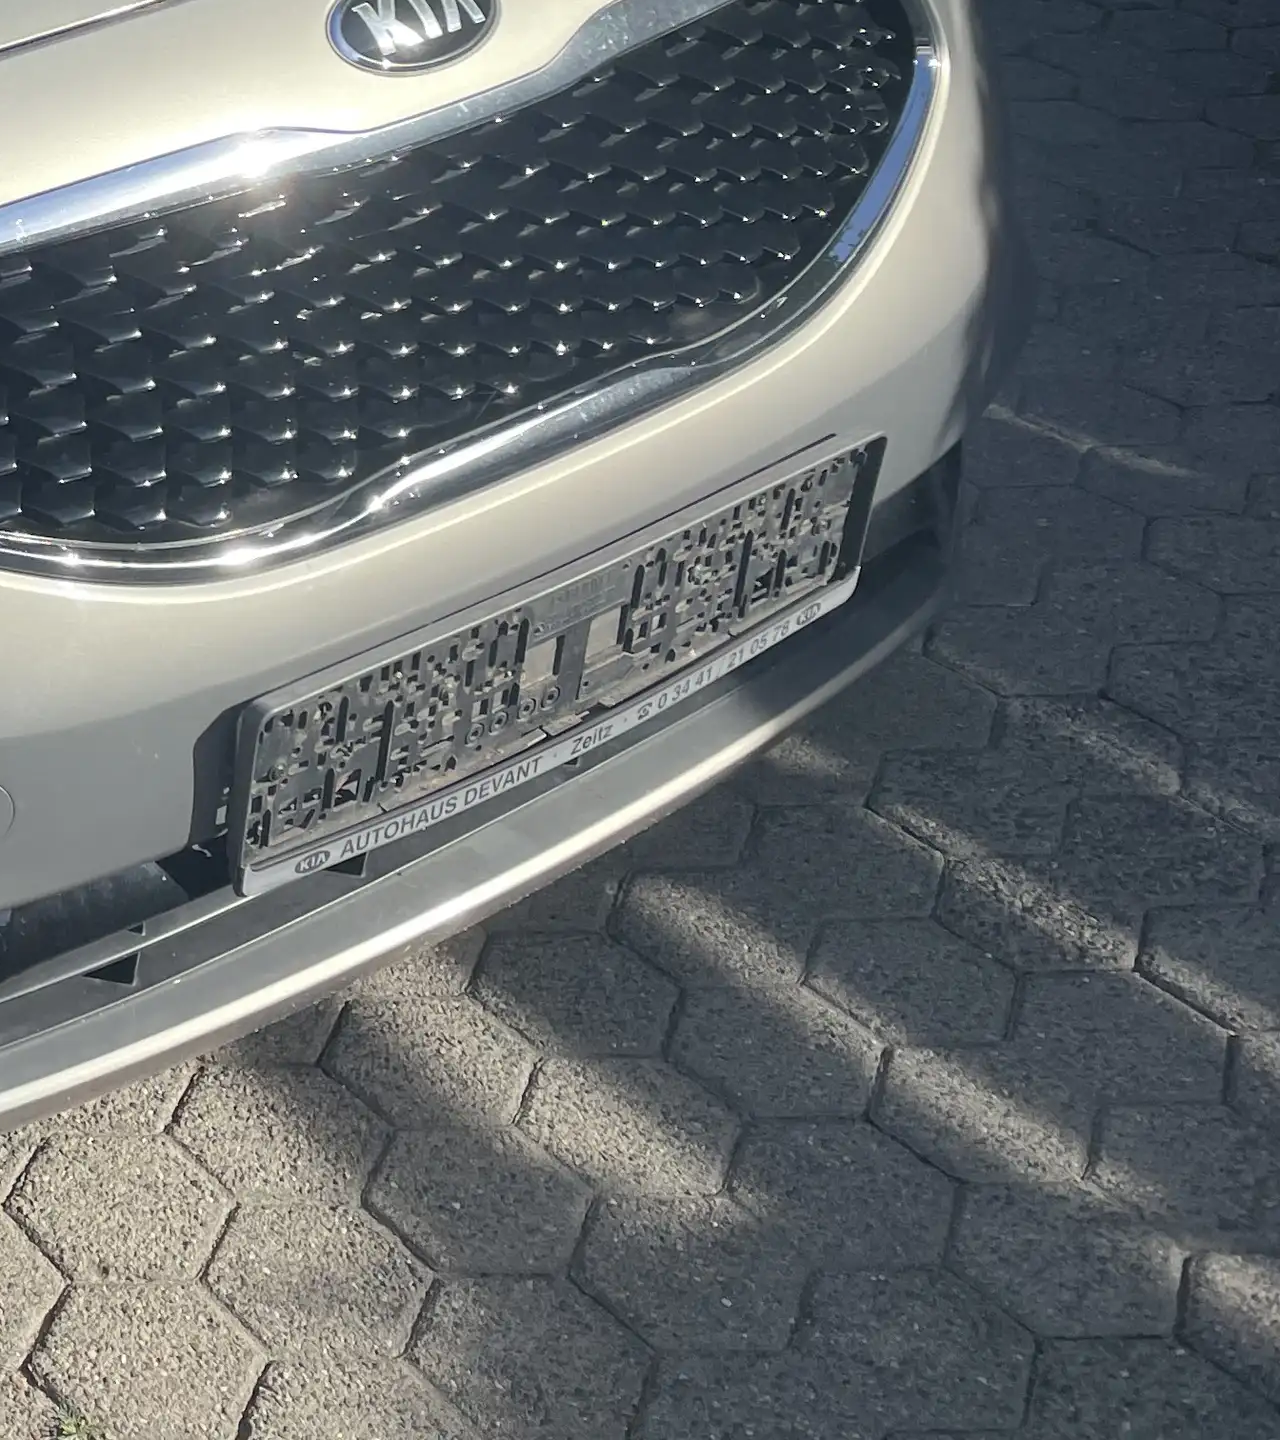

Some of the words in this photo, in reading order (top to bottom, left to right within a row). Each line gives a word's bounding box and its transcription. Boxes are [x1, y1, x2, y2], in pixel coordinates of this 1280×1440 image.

[299, 853, 328, 872] KIA
[340, 796, 458, 858] AUTOHAUS
[463, 756, 544, 807] DEVANT
[570, 723, 614, 755] Zeitz
[657, 692, 668, 709] 0
[671, 679, 691, 702] 34
[695, 666, 713, 686] 41
[726, 648, 745, 670] 21
[749, 634, 769, 655] 05
[772, 621, 790, 643] 78
